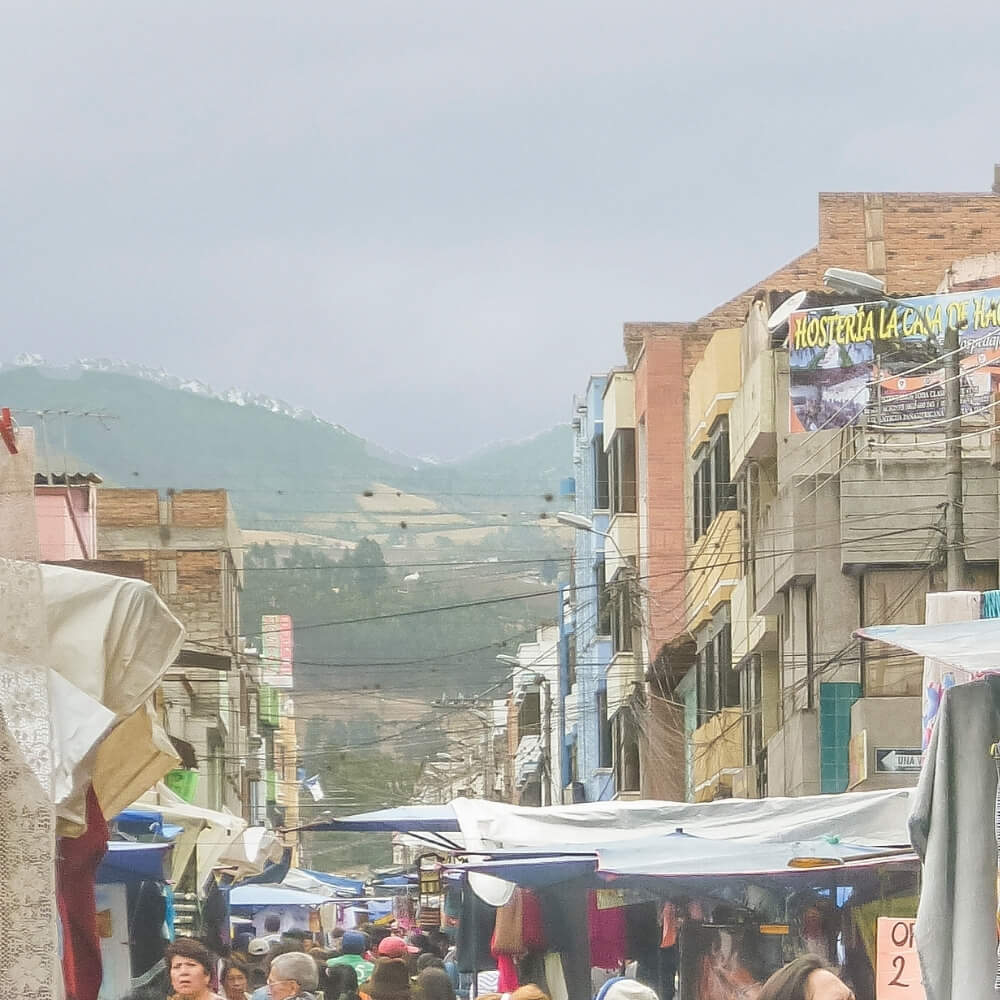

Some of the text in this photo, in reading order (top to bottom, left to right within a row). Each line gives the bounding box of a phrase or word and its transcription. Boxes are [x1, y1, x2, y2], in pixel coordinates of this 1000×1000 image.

[794, 305, 875, 350] HOSTERÍA
[880, 307, 899, 339] LA
[888, 955, 910, 987] 2
